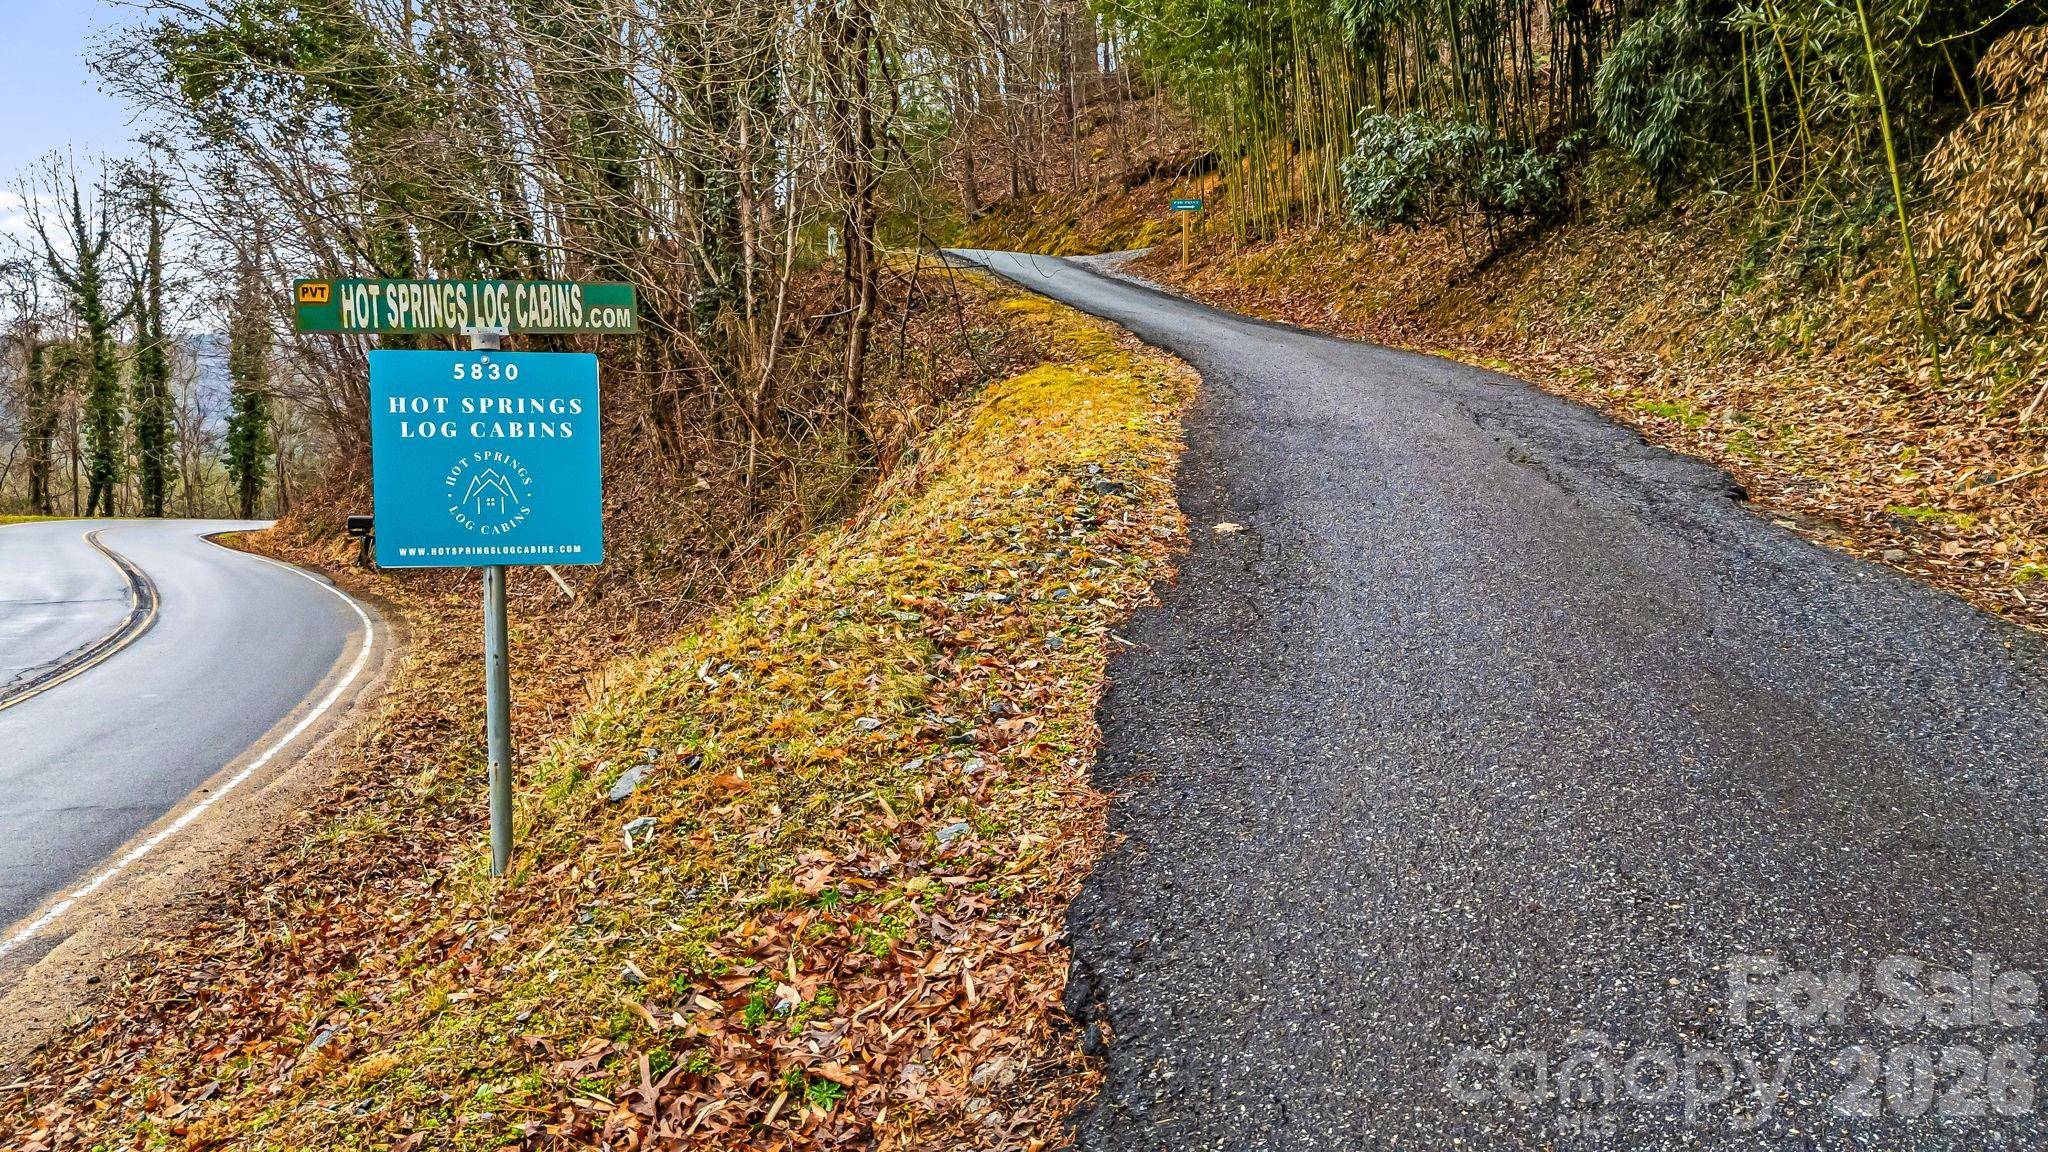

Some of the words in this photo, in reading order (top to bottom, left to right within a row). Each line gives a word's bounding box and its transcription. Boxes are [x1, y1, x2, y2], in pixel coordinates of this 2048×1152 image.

[301, 286, 326, 298] PVT
[341, 283, 380, 329] HOT
[386, 283, 469, 328] SPRINGS
[472, 283, 511, 328] LOG
[453, 363, 518, 380] 5830
[389, 396, 449, 414] HOT
[461, 397, 582, 415] SPRINGS
[400, 421, 457, 438] LOG
[470, 421, 573, 438] CABINS
[446, 457, 469, 487] HOT
[474, 450, 532, 485] SPRINGS
[449, 505, 475, 530] LOG
[481, 506, 531, 535] CABINS
[400, 545, 581, 556] WWW.HOTSPRINGSLOGCABINS.COM
